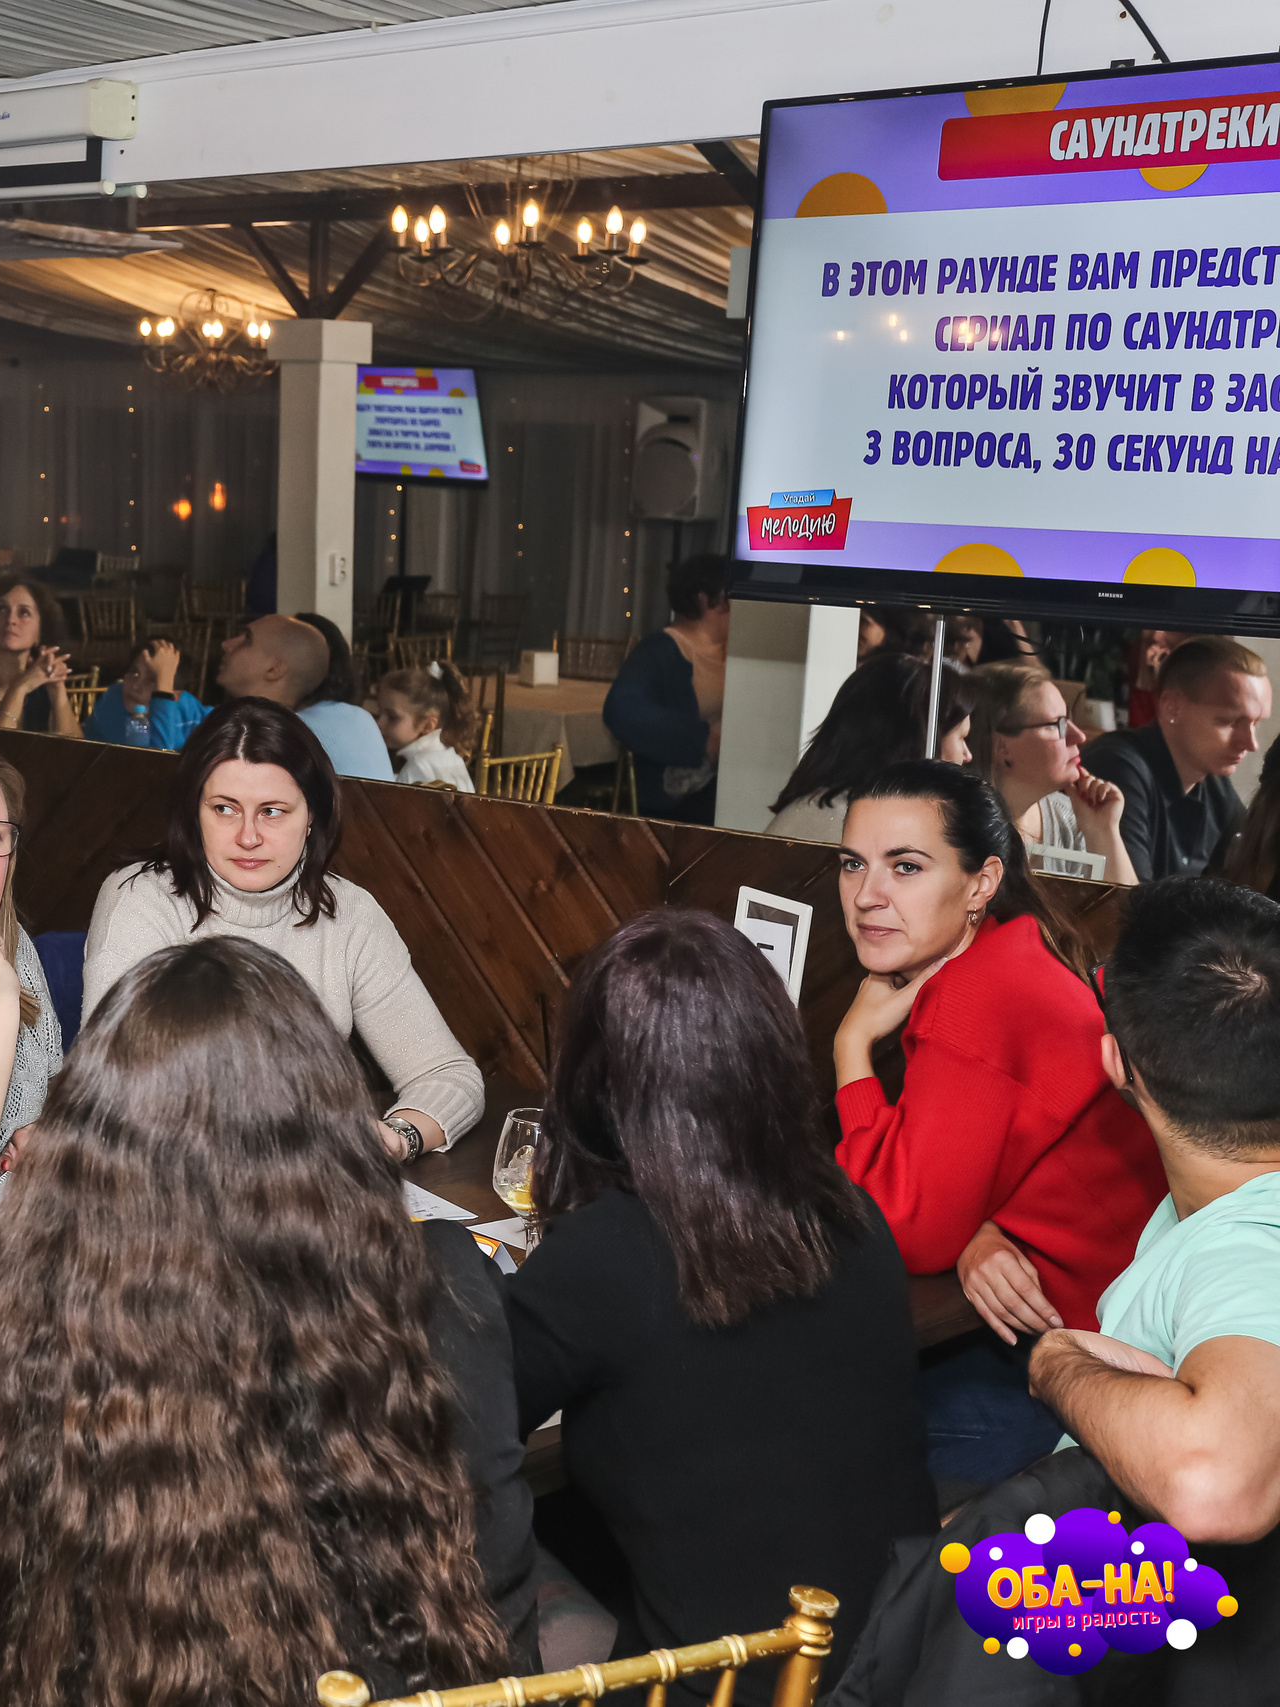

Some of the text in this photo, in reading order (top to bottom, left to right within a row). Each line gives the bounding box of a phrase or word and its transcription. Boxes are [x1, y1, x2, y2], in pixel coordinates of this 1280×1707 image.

[1049, 102, 1280, 161] САУНДТРЕКИ
[822, 245, 1280, 297] В ЭТОМ РАУНДЕ ВАМ ПРЕДСТ
[935, 309, 1280, 352] СЕРИАЛ ПО САУНДТР
[887, 366, 1043, 411] КОТОРЫЙ
[1051, 373, 1182, 412] ЗВУЧИТ
[1190, 373, 1215, 412] В
[863, 429, 882, 465] 3
[891, 430, 1042, 474] ВОПРОСА,
[1052, 432, 1096, 471] 30
[1107, 434, 1234, 475] СЕКУНД
[783, 493, 816, 504] Угадай
